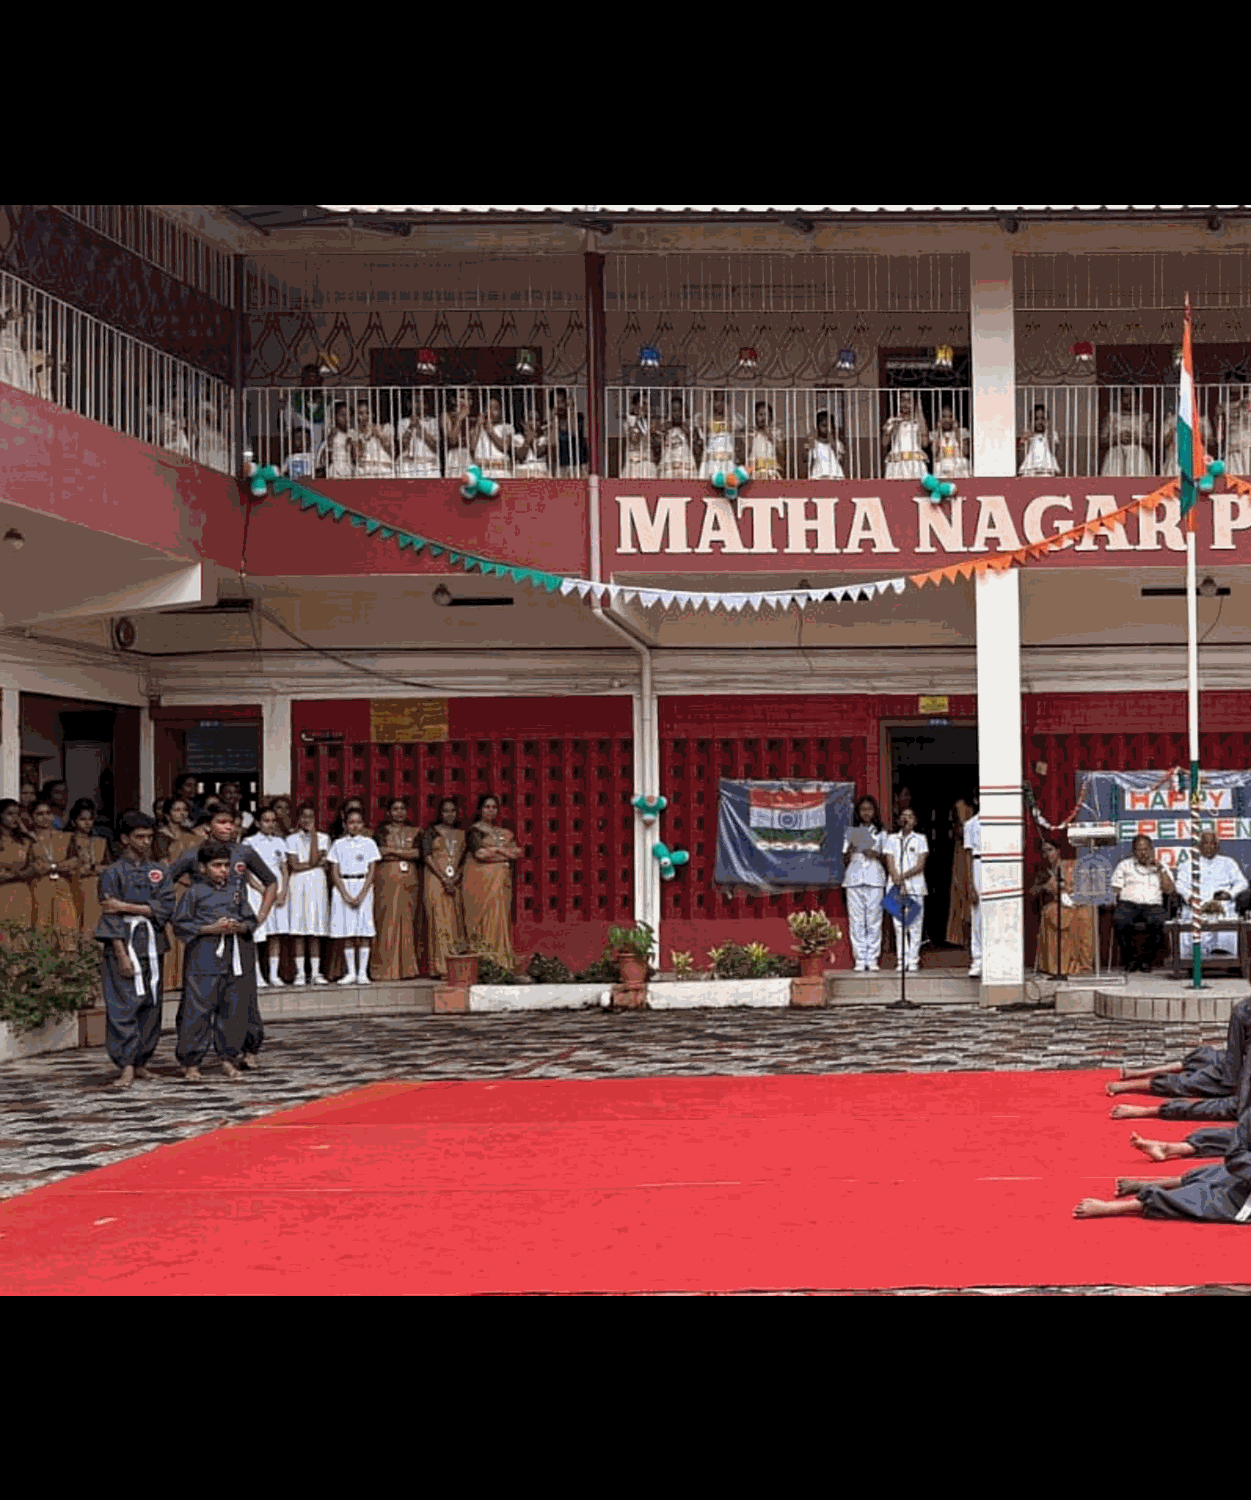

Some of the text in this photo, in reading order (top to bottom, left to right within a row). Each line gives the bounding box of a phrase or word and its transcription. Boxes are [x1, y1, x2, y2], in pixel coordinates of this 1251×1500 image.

[615, 496, 897, 553] MATHA
[913, 493, 1186, 553] NAGAR
[1130, 790, 1224, 810] HAPPY
[1156, 848, 1191, 868] DA
